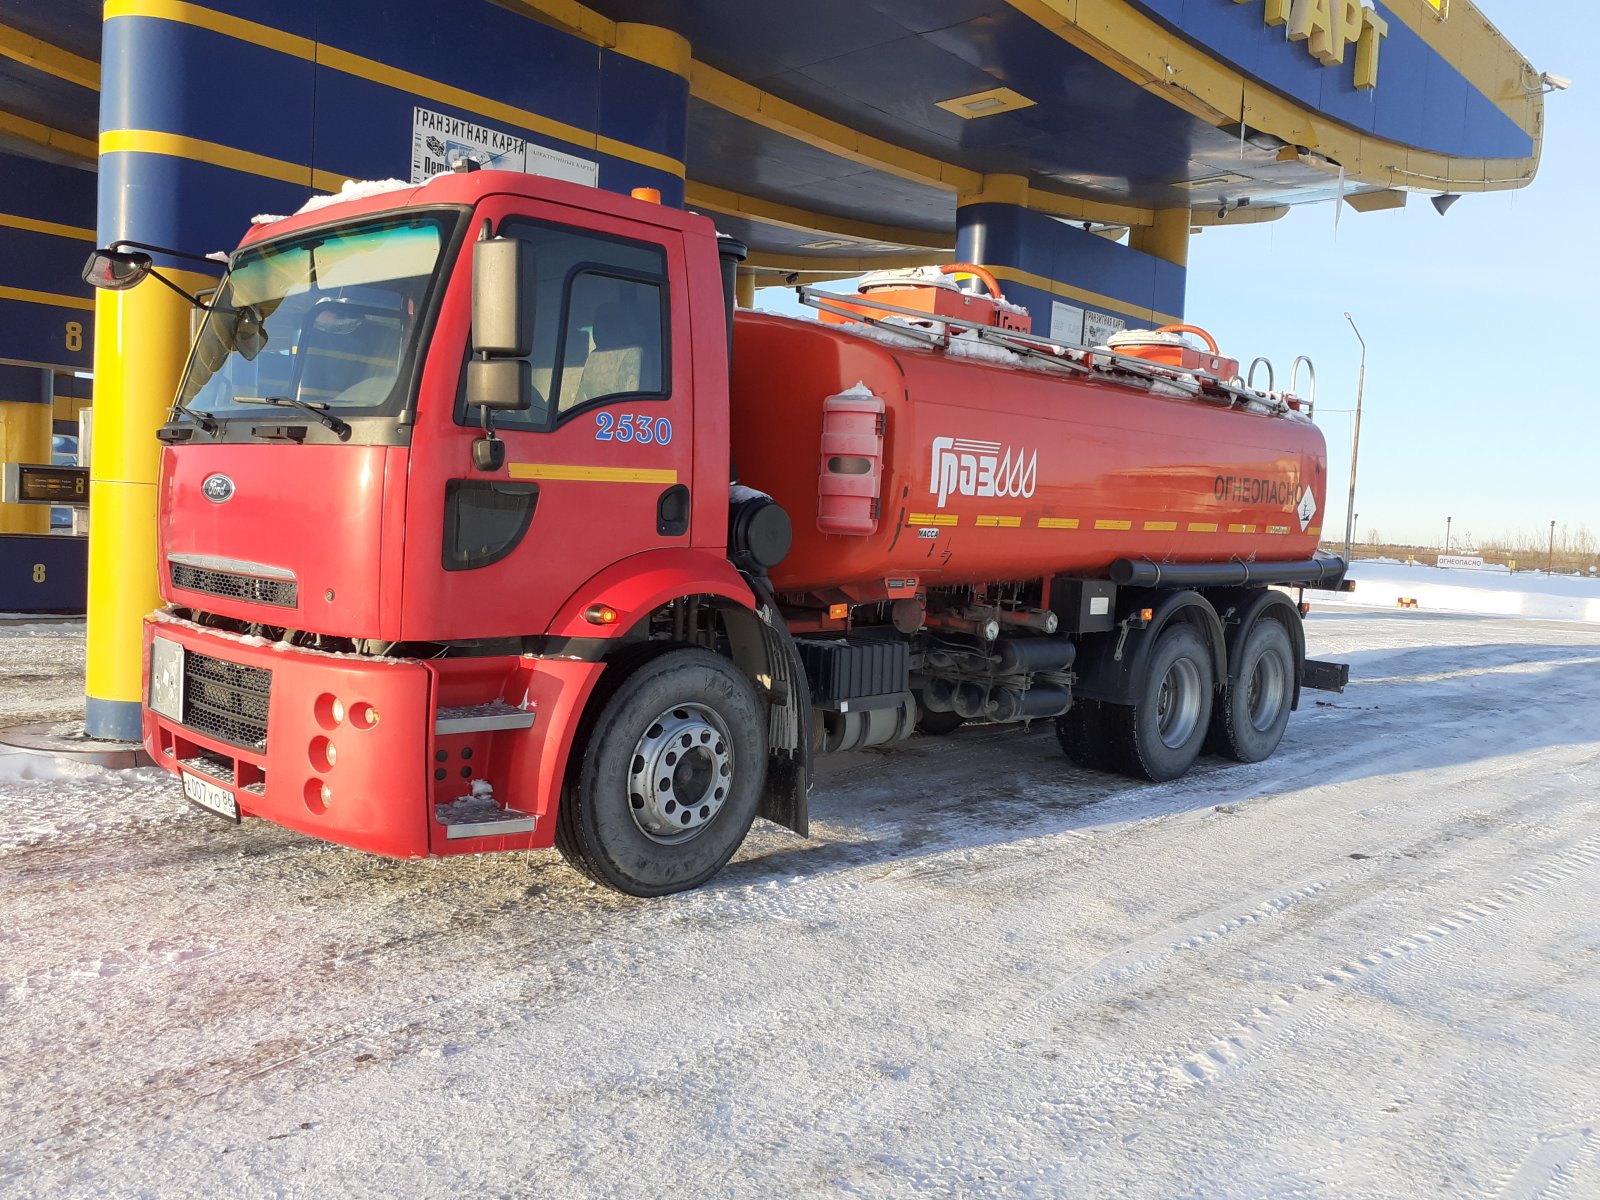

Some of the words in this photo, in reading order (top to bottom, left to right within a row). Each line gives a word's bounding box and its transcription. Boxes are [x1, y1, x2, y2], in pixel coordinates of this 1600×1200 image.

[492, 132, 525, 155] КАРТА
[66, 321, 82, 351] 8
[595, 411, 673, 446] 2530
[75, 477, 85, 494] 8
[207, 478, 226, 496] Ford
[1214, 474, 1302, 505] ОГНЕОПАСНО
[32, 563, 46, 583] 8
[1438, 558, 1482, 567] ОГНЕОПАСНО
